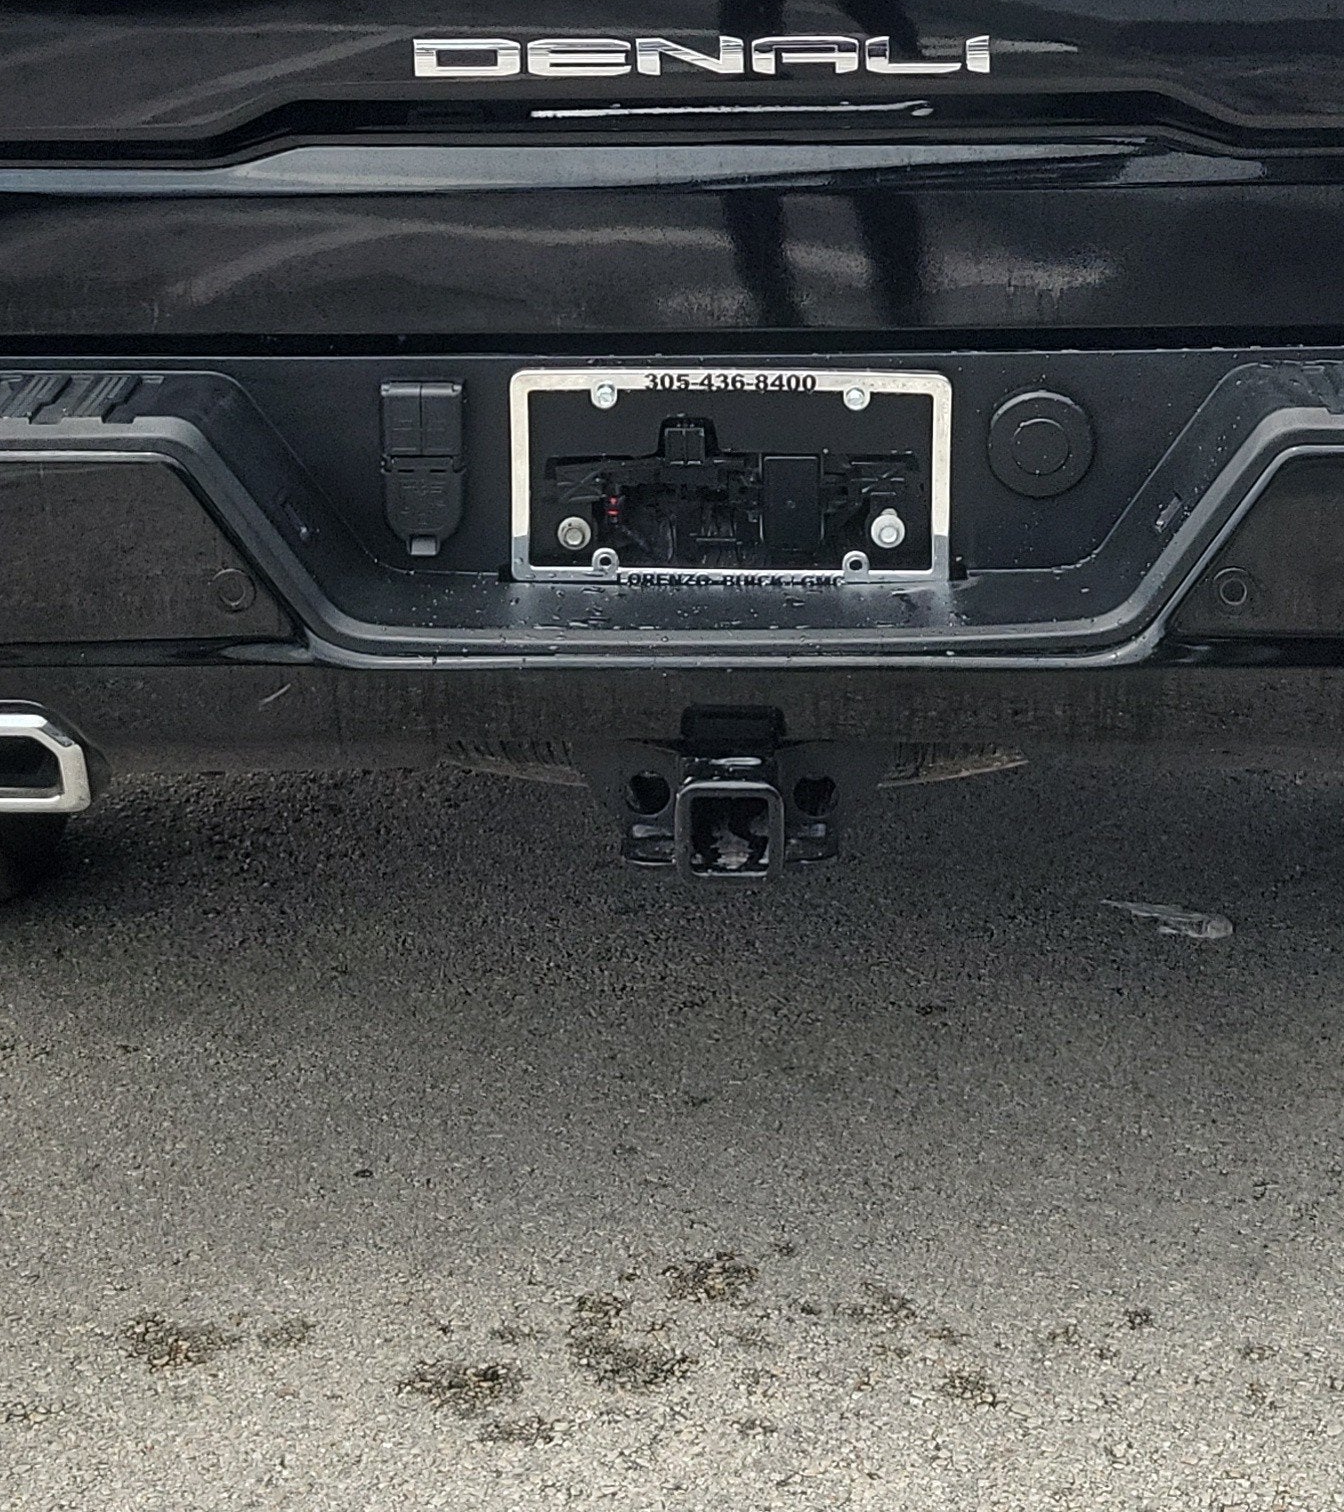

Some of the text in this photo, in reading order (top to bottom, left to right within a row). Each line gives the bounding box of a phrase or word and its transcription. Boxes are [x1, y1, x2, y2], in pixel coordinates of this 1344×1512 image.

[413, 34, 990, 77] DENALI
[644, 372, 817, 391] 305-436-8400
[616, 572, 711, 587] LORENZO
